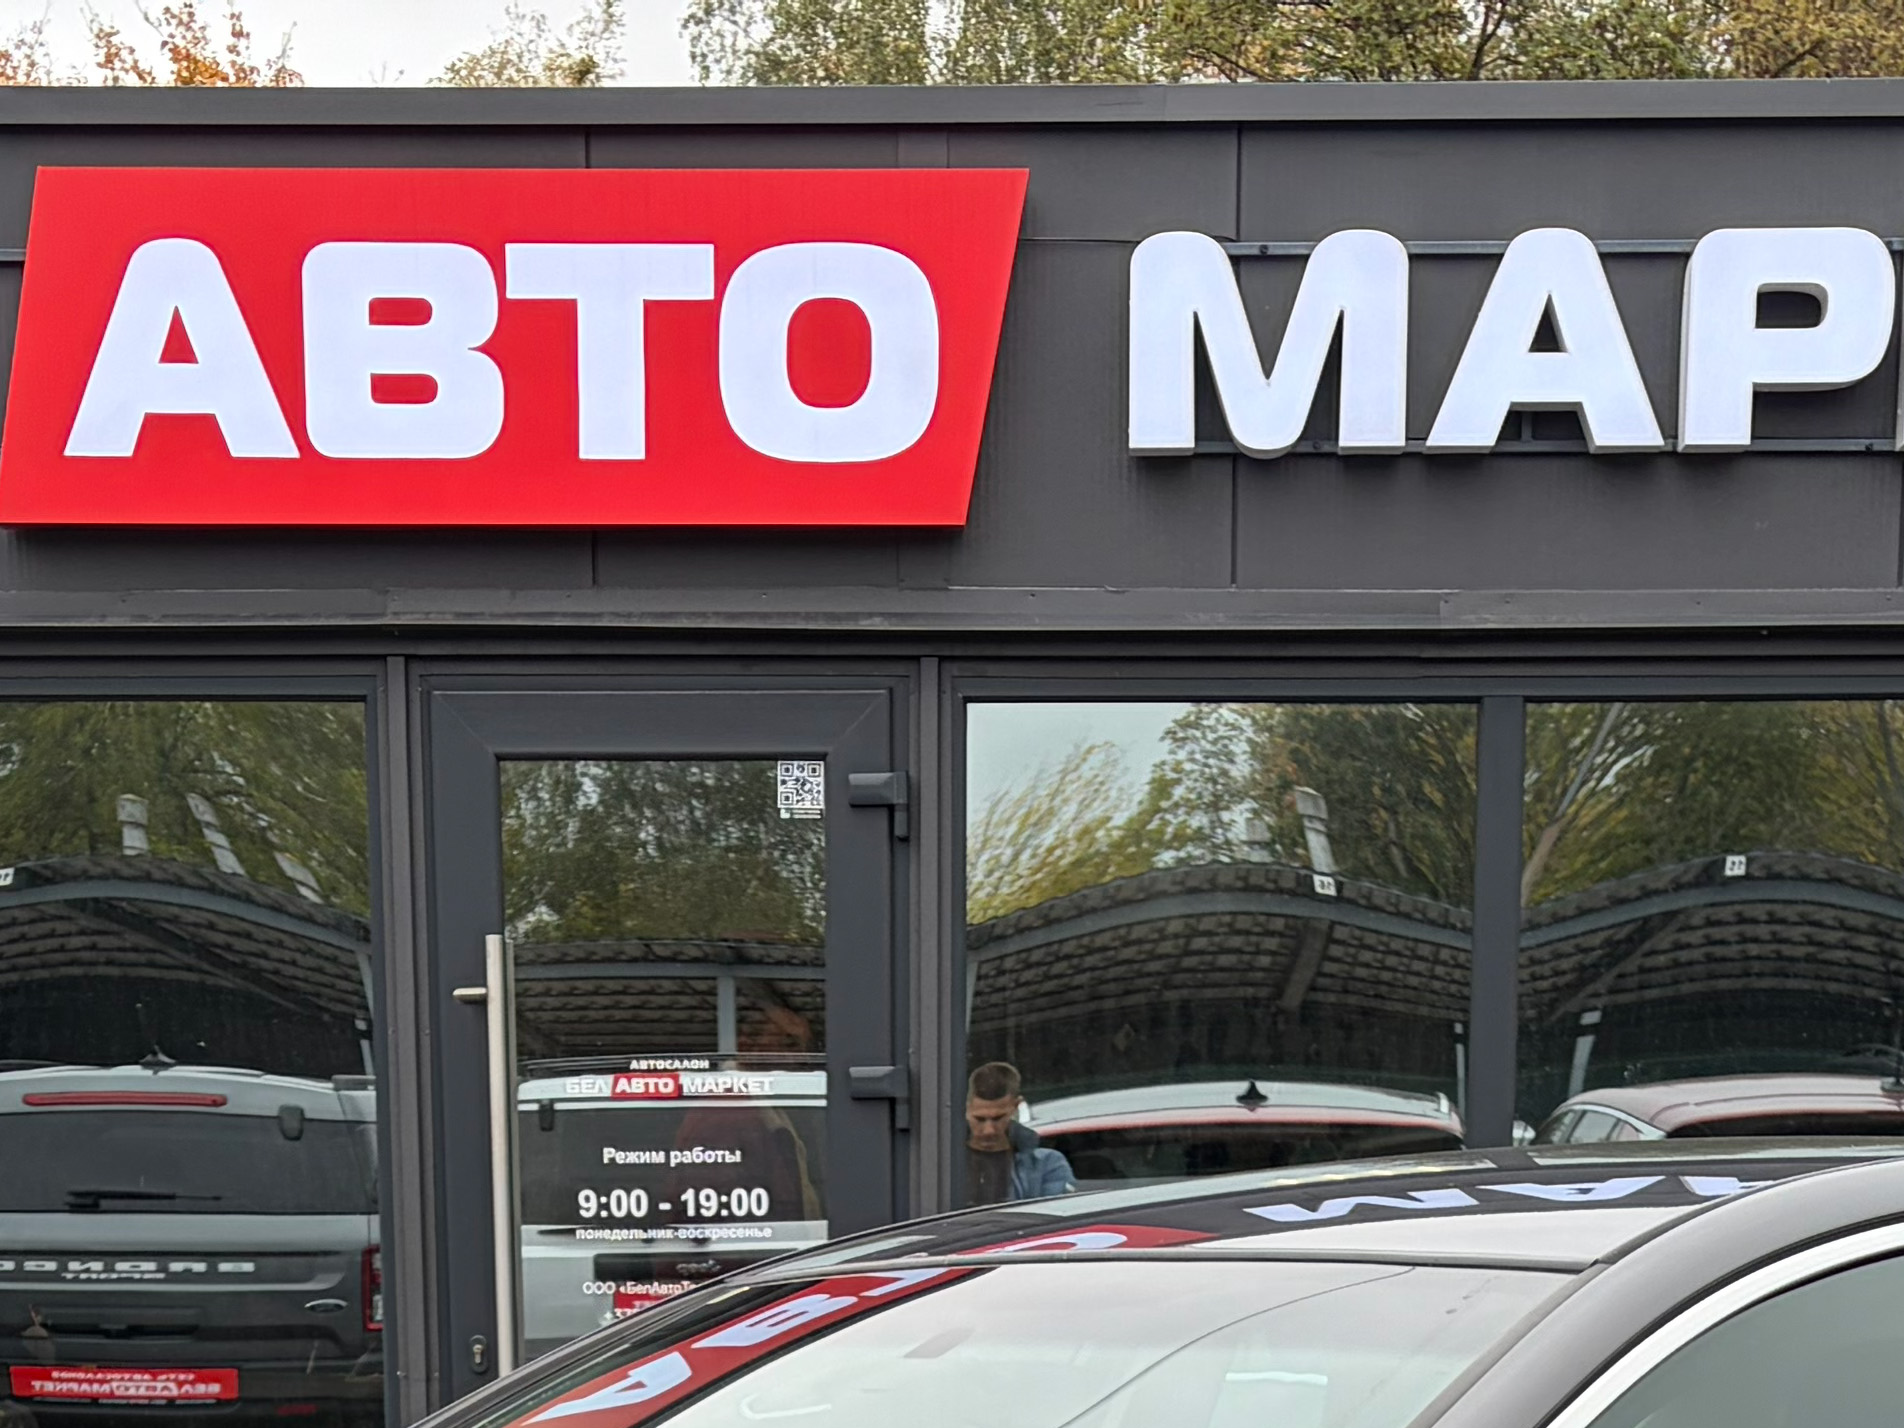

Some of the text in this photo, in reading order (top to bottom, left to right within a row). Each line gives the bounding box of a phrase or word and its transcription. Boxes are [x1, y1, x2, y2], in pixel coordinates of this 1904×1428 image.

[63, 237, 941, 462] АВТО
[629, 1059, 710, 1070] АВТОСАЛОН
[566, 1075, 775, 1094] БЕЛ АВТО МАРКЕТ
[602, 1146, 742, 1167] Режим работы
[577, 1188, 649, 1218] 9:00
[680, 1187, 770, 1217] 19:00
[575, 1225, 773, 1240] понедельник-воскресенье
[582, 1281, 616, 1295] ООО
